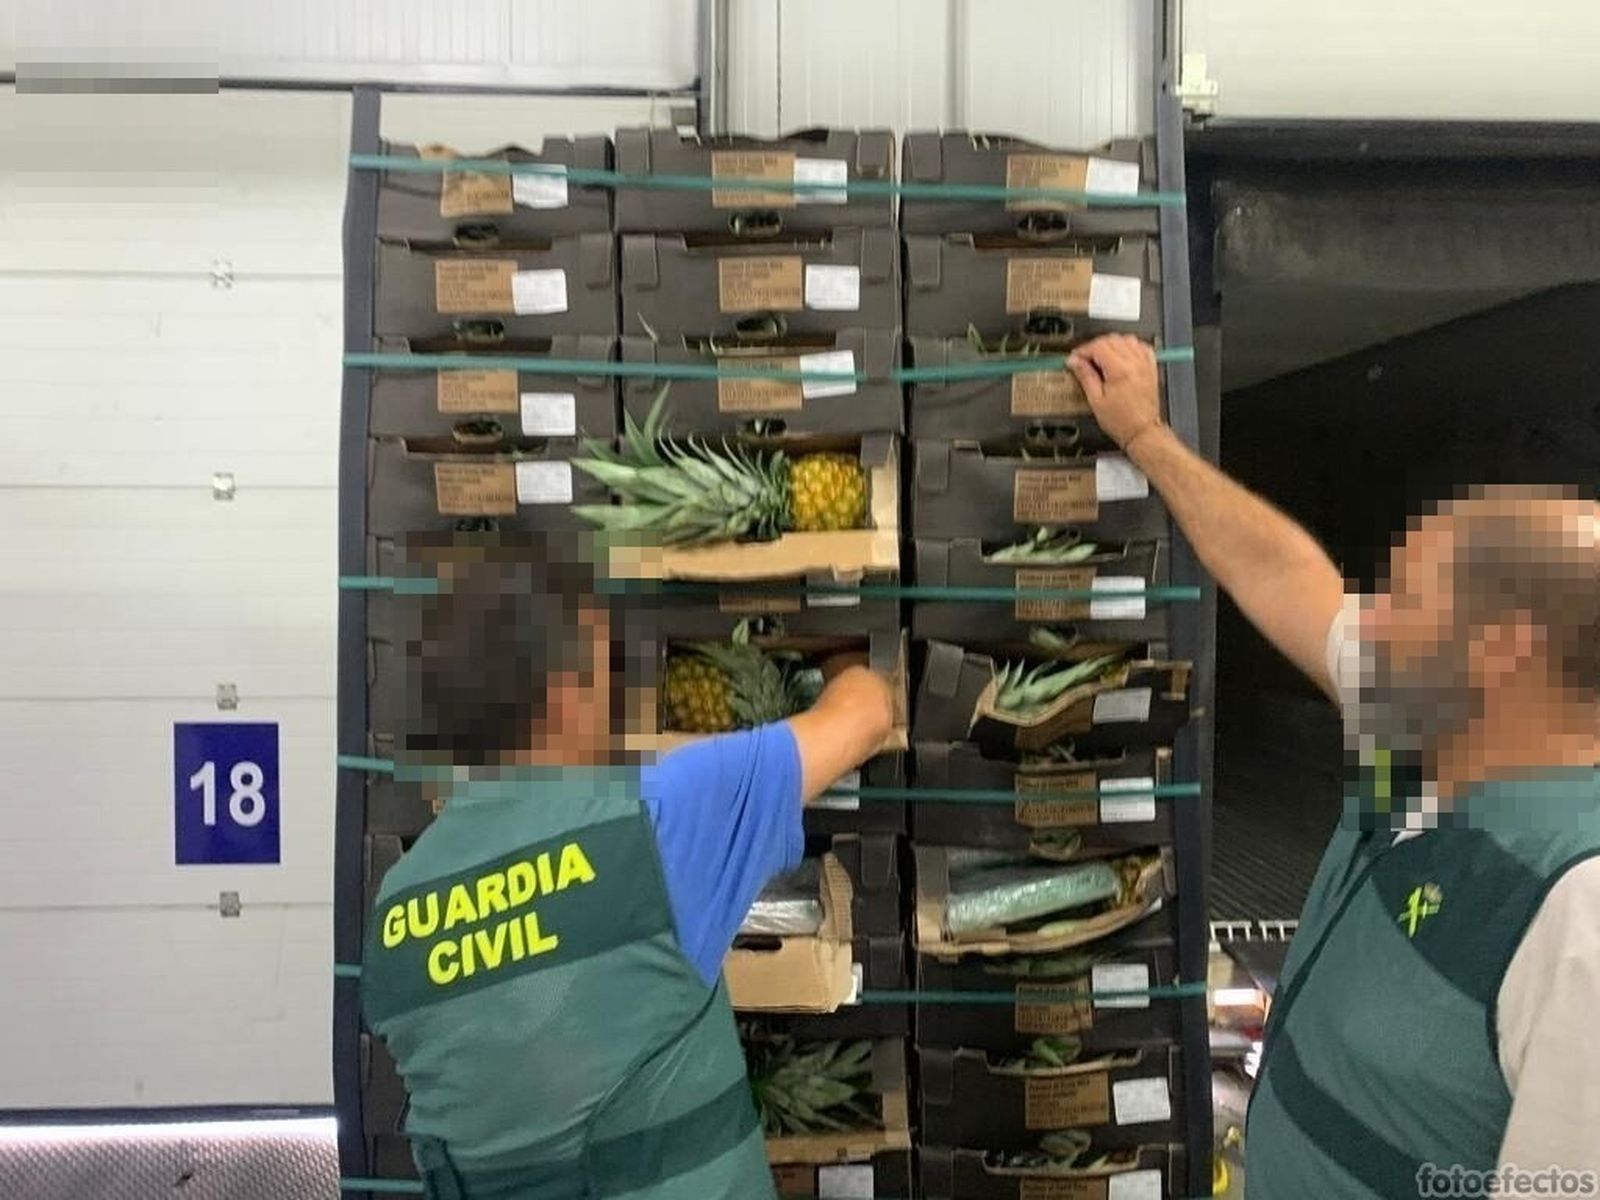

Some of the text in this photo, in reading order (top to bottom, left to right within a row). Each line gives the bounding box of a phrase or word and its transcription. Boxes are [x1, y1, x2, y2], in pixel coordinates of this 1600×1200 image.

[190, 761, 266, 827] 18
[383, 842, 596, 949] GUARDIA
[427, 911, 559, 985] CIVIL
